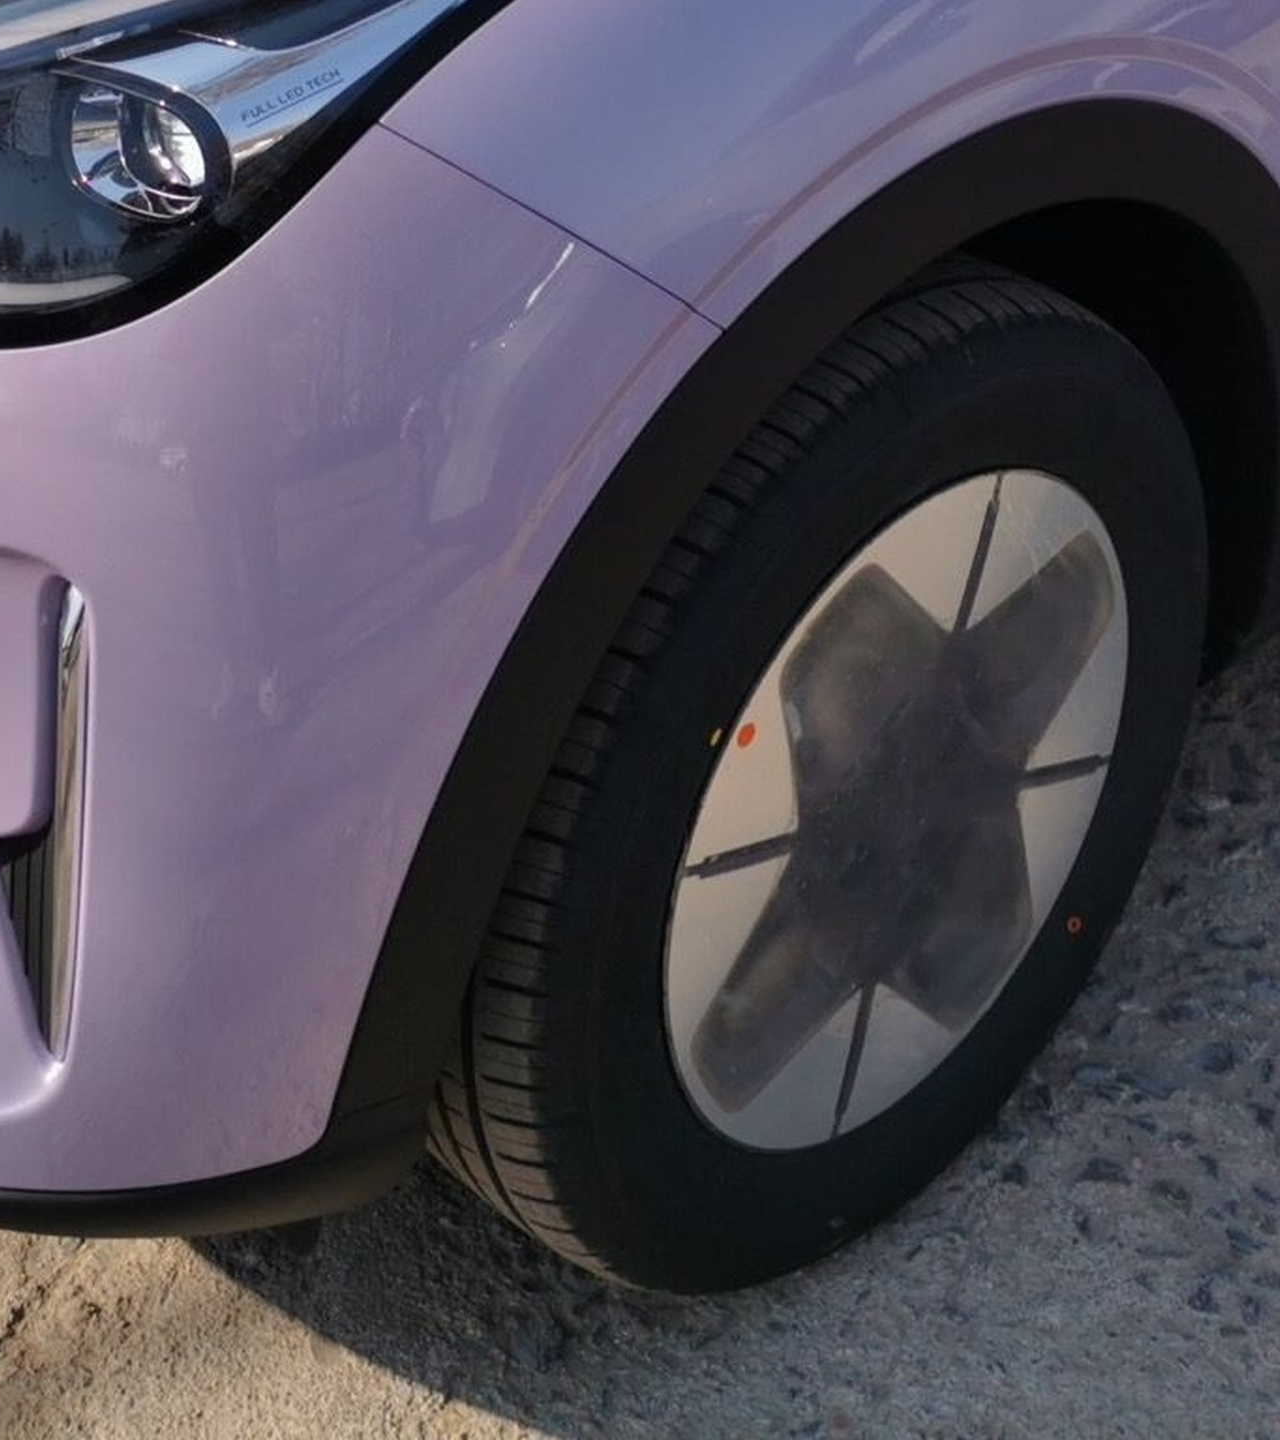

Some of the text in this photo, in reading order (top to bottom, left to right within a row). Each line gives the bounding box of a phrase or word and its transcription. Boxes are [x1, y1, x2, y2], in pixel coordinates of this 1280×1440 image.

[241, 68, 340, 121] FULL LED TECH
